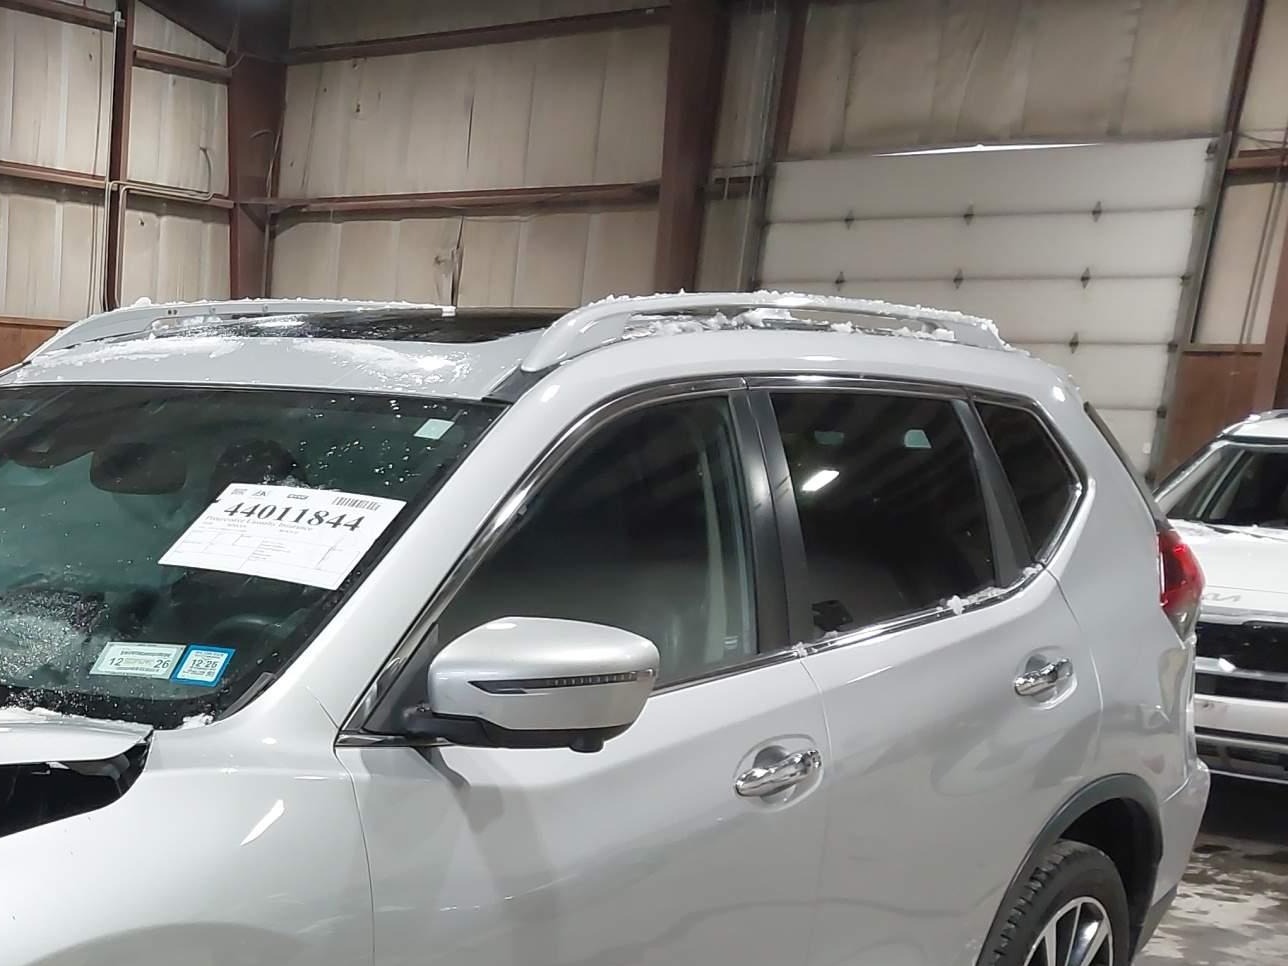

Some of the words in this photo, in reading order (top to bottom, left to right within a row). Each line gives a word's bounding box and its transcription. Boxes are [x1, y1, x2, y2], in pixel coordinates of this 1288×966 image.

[223, 501, 366, 532] 44011844
[108, 657, 124, 667] 12
[153, 659, 171, 669] 26
